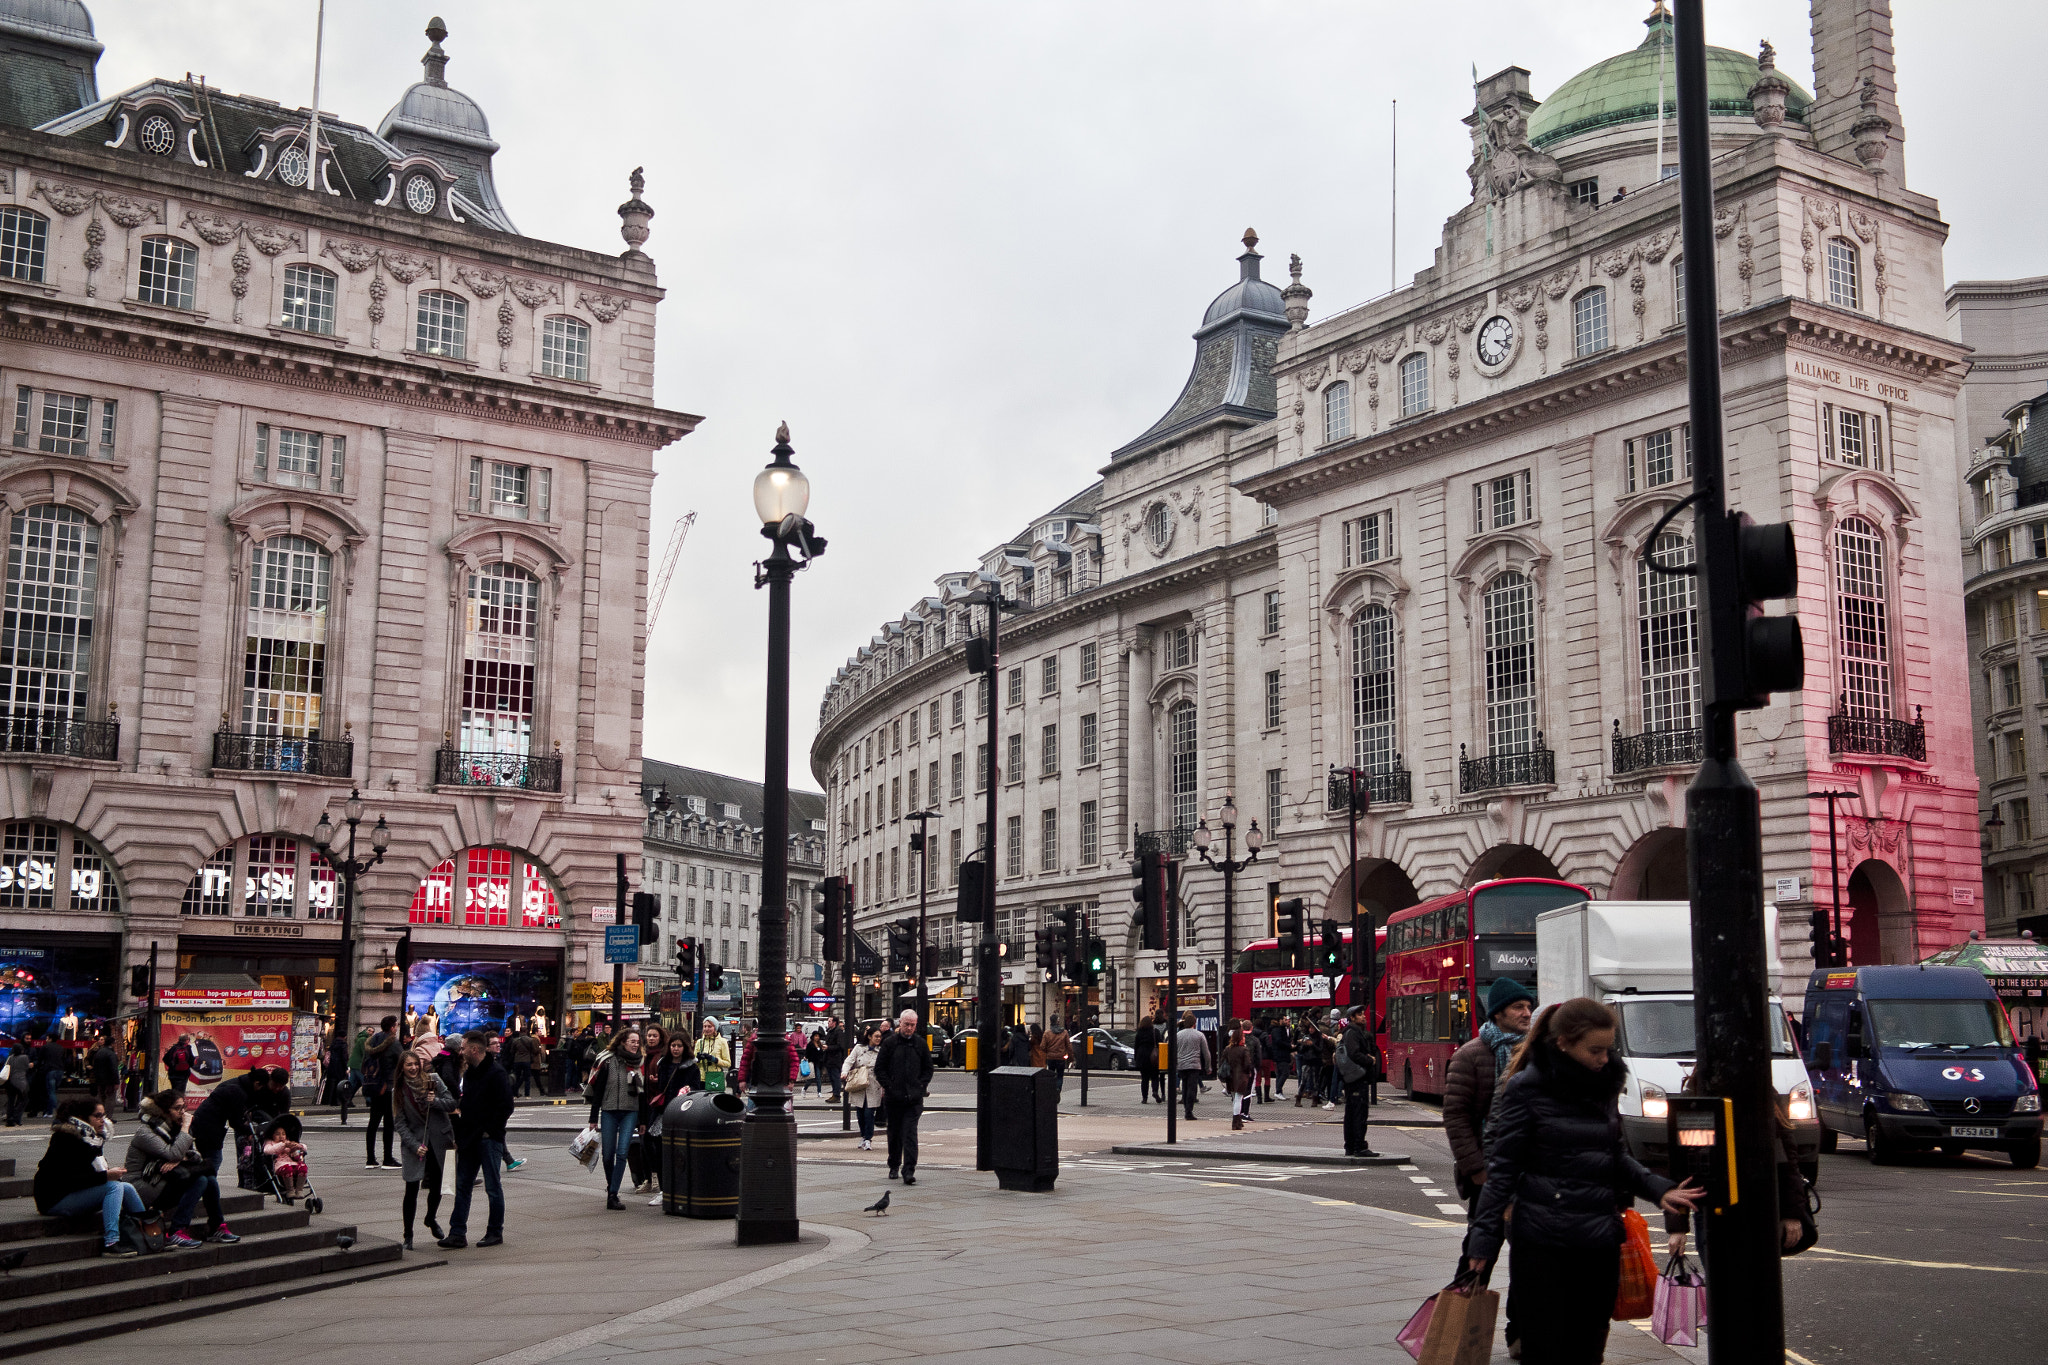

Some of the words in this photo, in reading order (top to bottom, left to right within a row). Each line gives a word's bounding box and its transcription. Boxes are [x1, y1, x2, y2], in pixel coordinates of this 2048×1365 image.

[1794, 361, 1841, 384] ALLIANCE
[1850, 376, 1869, 392] LIFE
[1878, 383, 1909, 402] OFFICE
[1916, 773, 1940, 785] OFFICE
[1521, 792, 1549, 804] FIRE
[17, 860, 101, 899] Stg
[261, 871, 335, 909] Stg
[477, 881, 544, 921] Stg
[237, 925, 260, 933] THE
[263, 926, 300, 935] STING
[859, 956, 873, 964] 150
[1153, 960, 1187, 974] NESPSO
[1979, 957, 2048, 972] WICKE
[1254, 980, 1269, 989] CAN
[1271, 978, 1306, 988] SOMEONE
[165, 1012, 197, 1023] hop-on
[200, 1014, 232, 1024] hop-off
[234, 1014, 254, 1022] BUS
[257, 1014, 289, 1022] TOURS
[1942, 1066, 1985, 1082] G4S
[1679, 1130, 1716, 1146] WAIT
[1954, 1127, 1977, 1136] KF53
[1980, 1128, 1996, 1136] AEW
